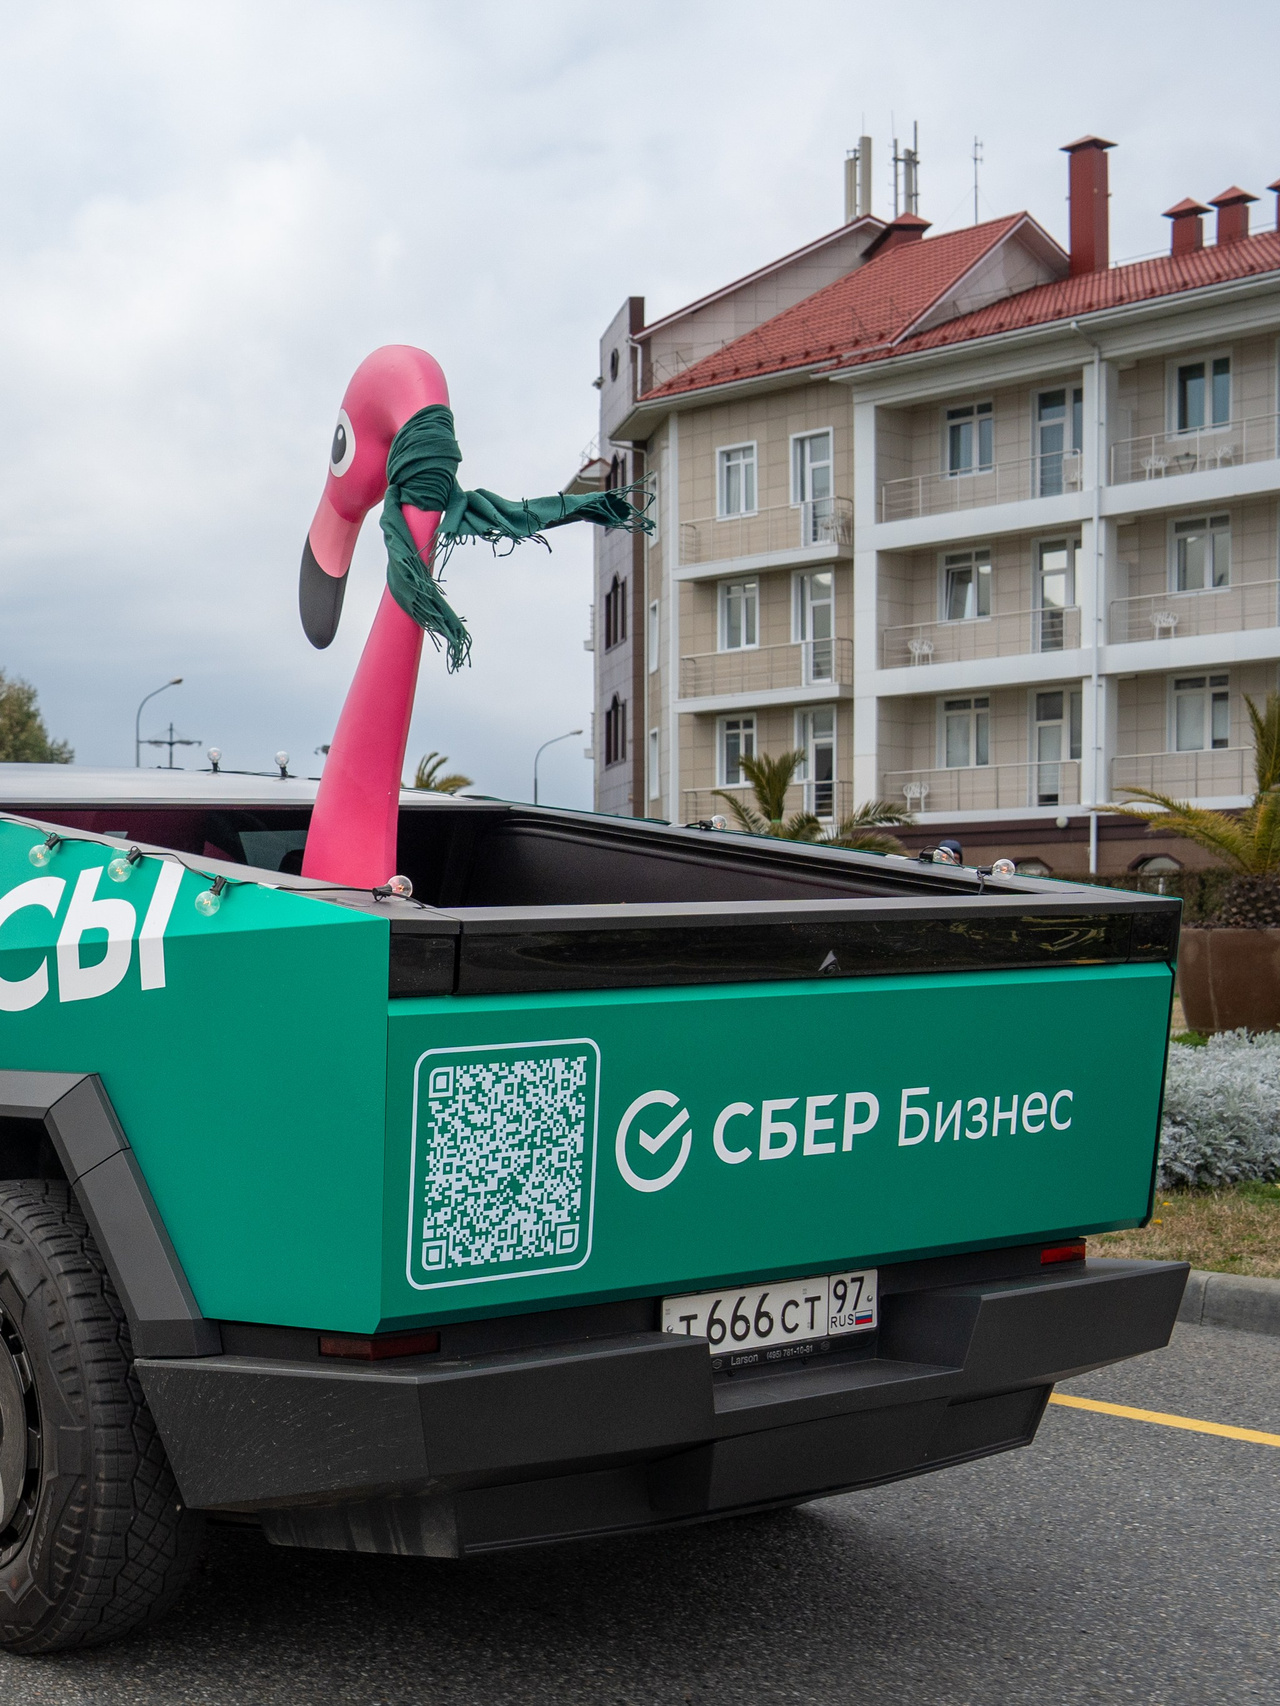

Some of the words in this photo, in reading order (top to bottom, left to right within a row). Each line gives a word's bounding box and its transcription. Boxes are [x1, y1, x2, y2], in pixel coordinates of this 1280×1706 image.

[713, 1090, 879, 1165] СБЕР
[898, 1087, 1073, 1148] Бизнес
[833, 1276, 865, 1314] 97
[831, 1310, 855, 1329] RUS
[730, 1353, 759, 1366] Larson
